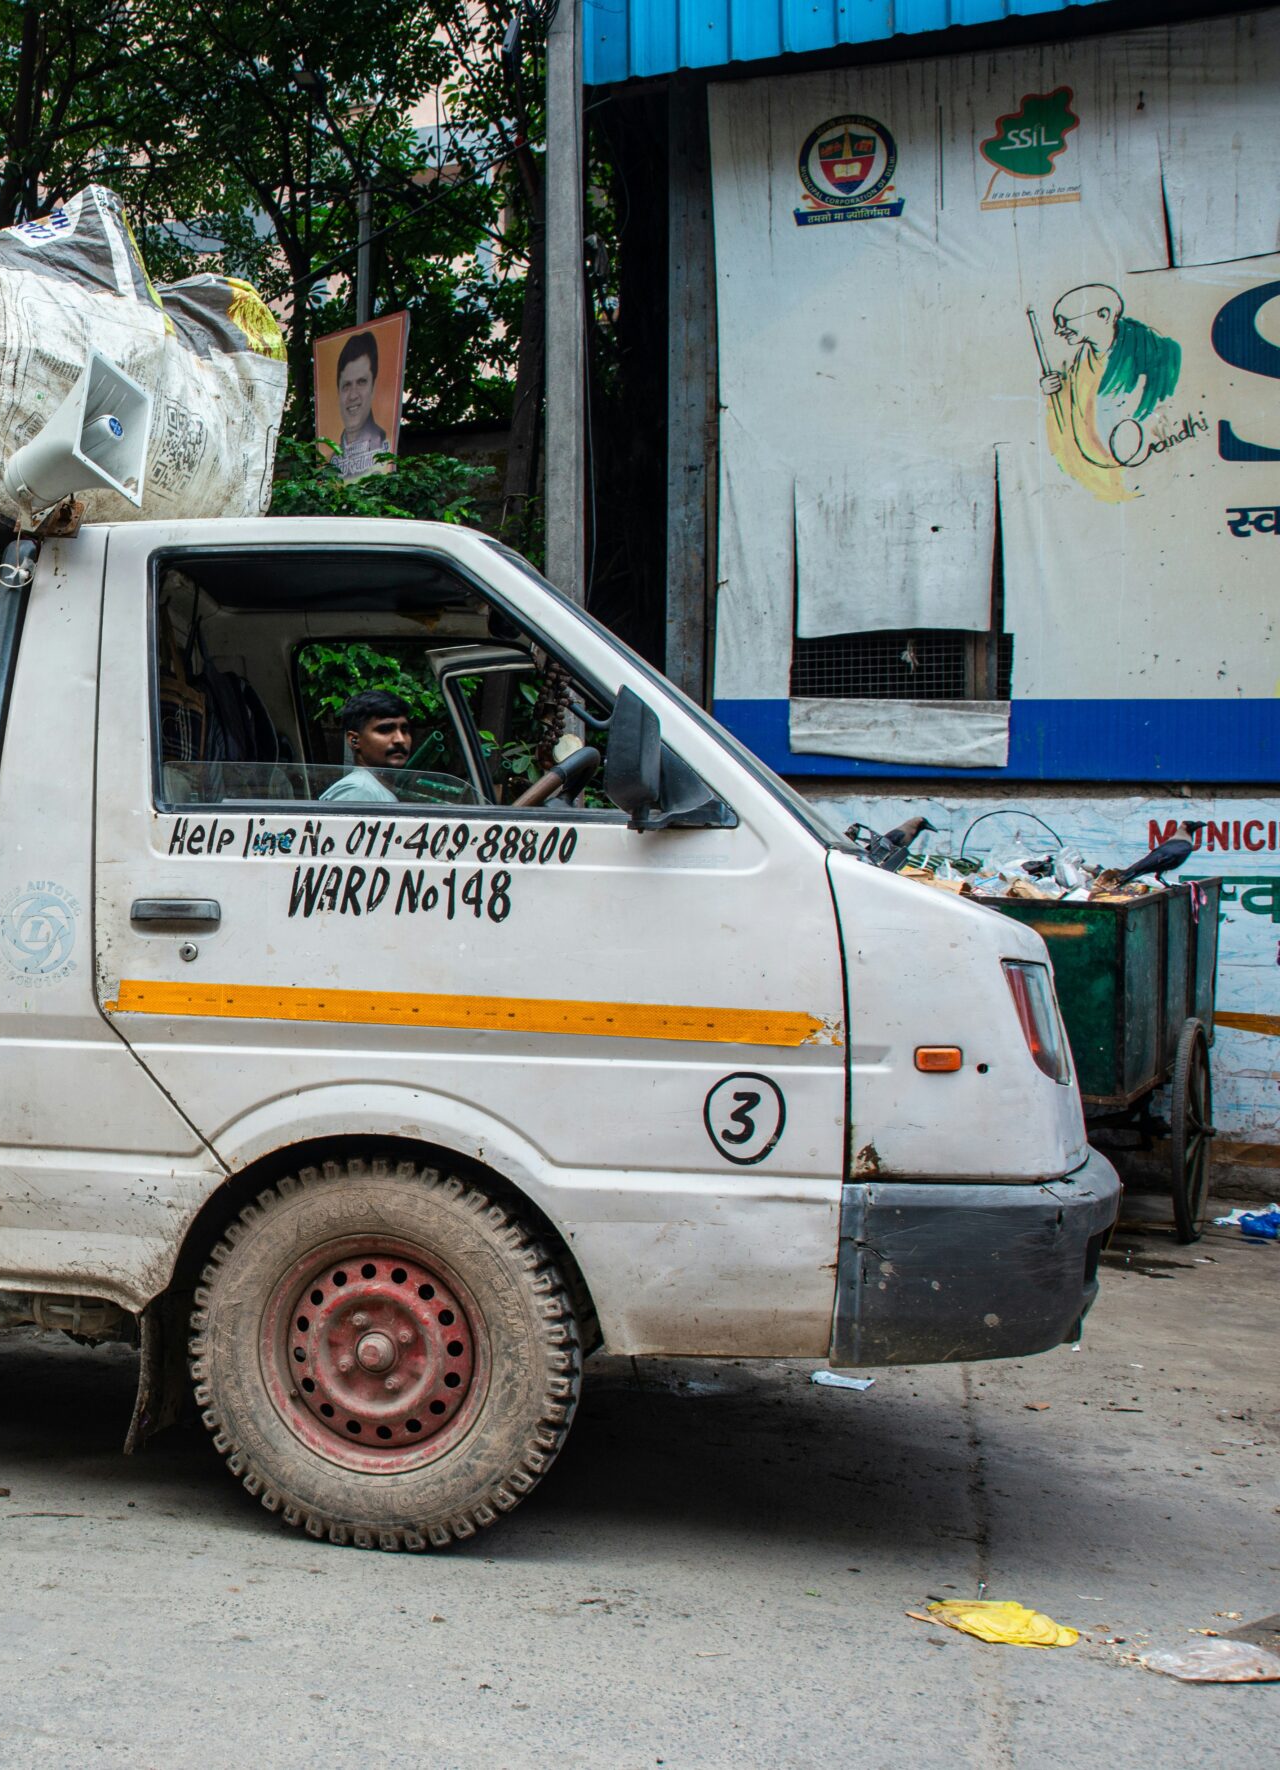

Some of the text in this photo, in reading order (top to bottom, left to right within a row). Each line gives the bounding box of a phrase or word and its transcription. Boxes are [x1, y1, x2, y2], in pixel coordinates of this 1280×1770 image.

[800, 165, 823, 199] MUNICIPAL
[824, 188, 878, 206] CORPORATION
[808, 212, 832, 223] तमसो
[833, 211, 844, 220] मा
[169, 817, 235, 857] Help
[288, 864, 391, 918] WARD
[442, 868, 512, 923] 148
[721, 1092, 762, 1144] 3
